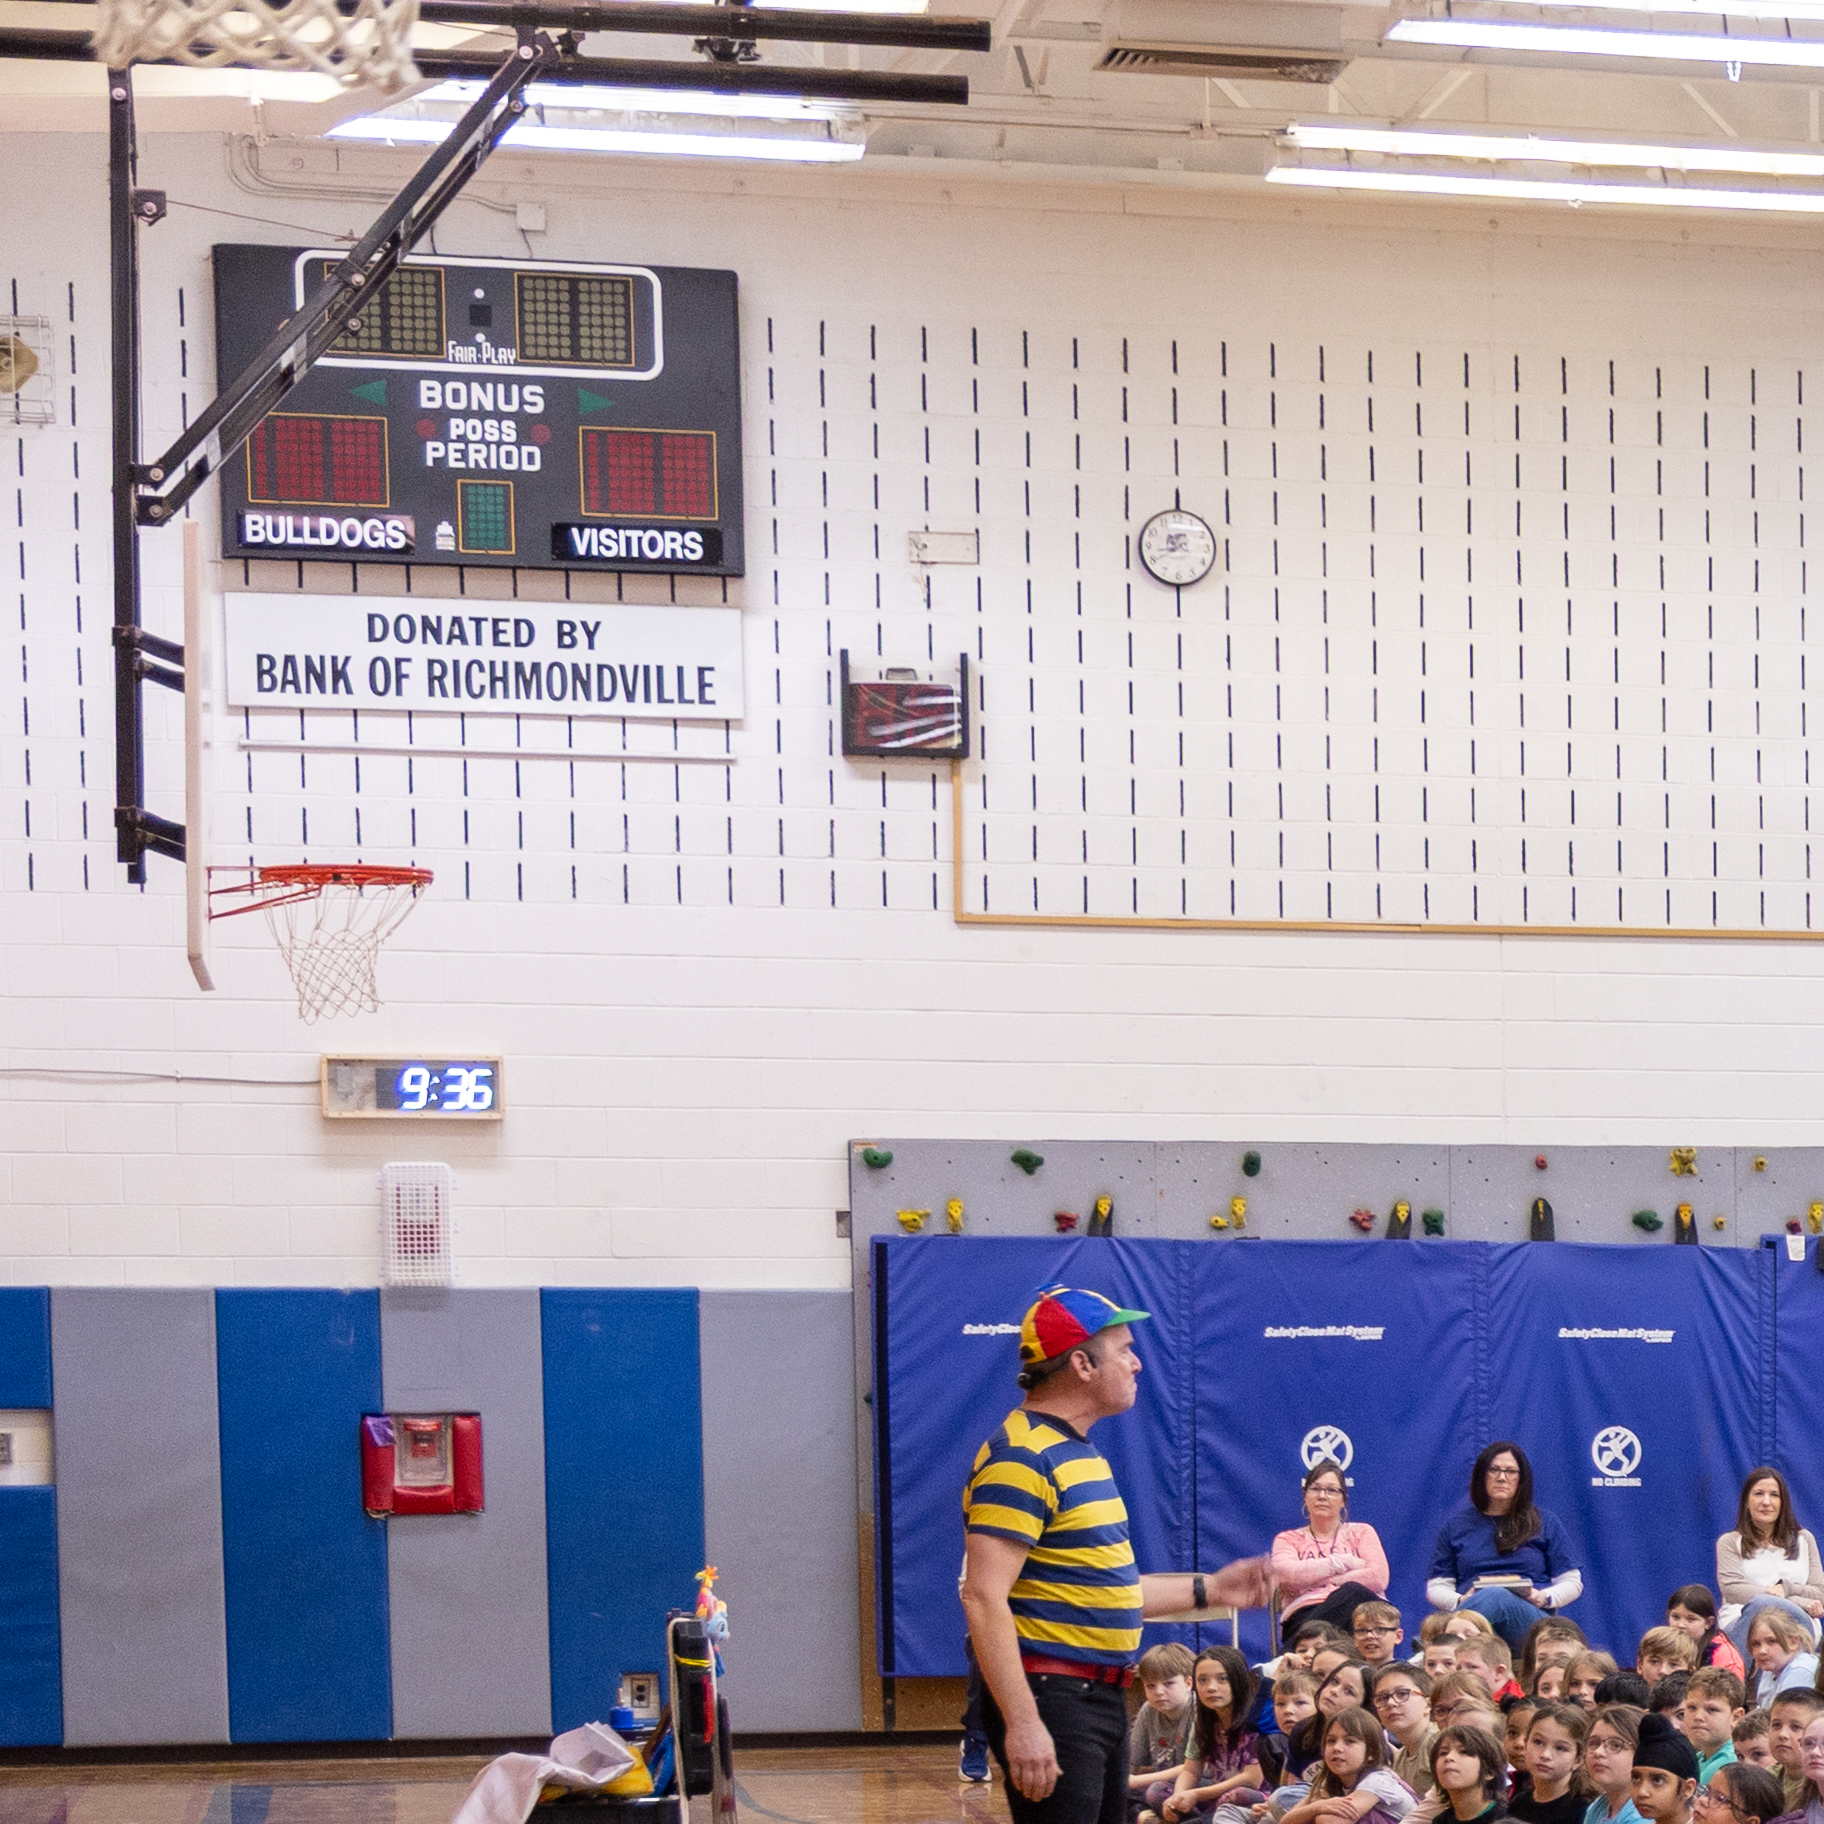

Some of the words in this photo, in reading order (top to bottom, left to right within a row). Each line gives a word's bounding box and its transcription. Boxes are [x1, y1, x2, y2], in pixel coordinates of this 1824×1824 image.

[420, 379, 545, 414] BONUS
[449, 418, 517, 442] POSS
[425, 442, 542, 472] PERIOD
[244, 514, 406, 549] BULLDOGS
[570, 528, 704, 560] VISITORS
[367, 612, 535, 648] DONATED
[557, 620, 602, 650] BY
[256, 653, 354, 696] BANK
[368, 656, 412, 698] OF
[427, 658, 716, 706] RICHMONDVILLE
[402, 1067, 493, 1110] 9:36
